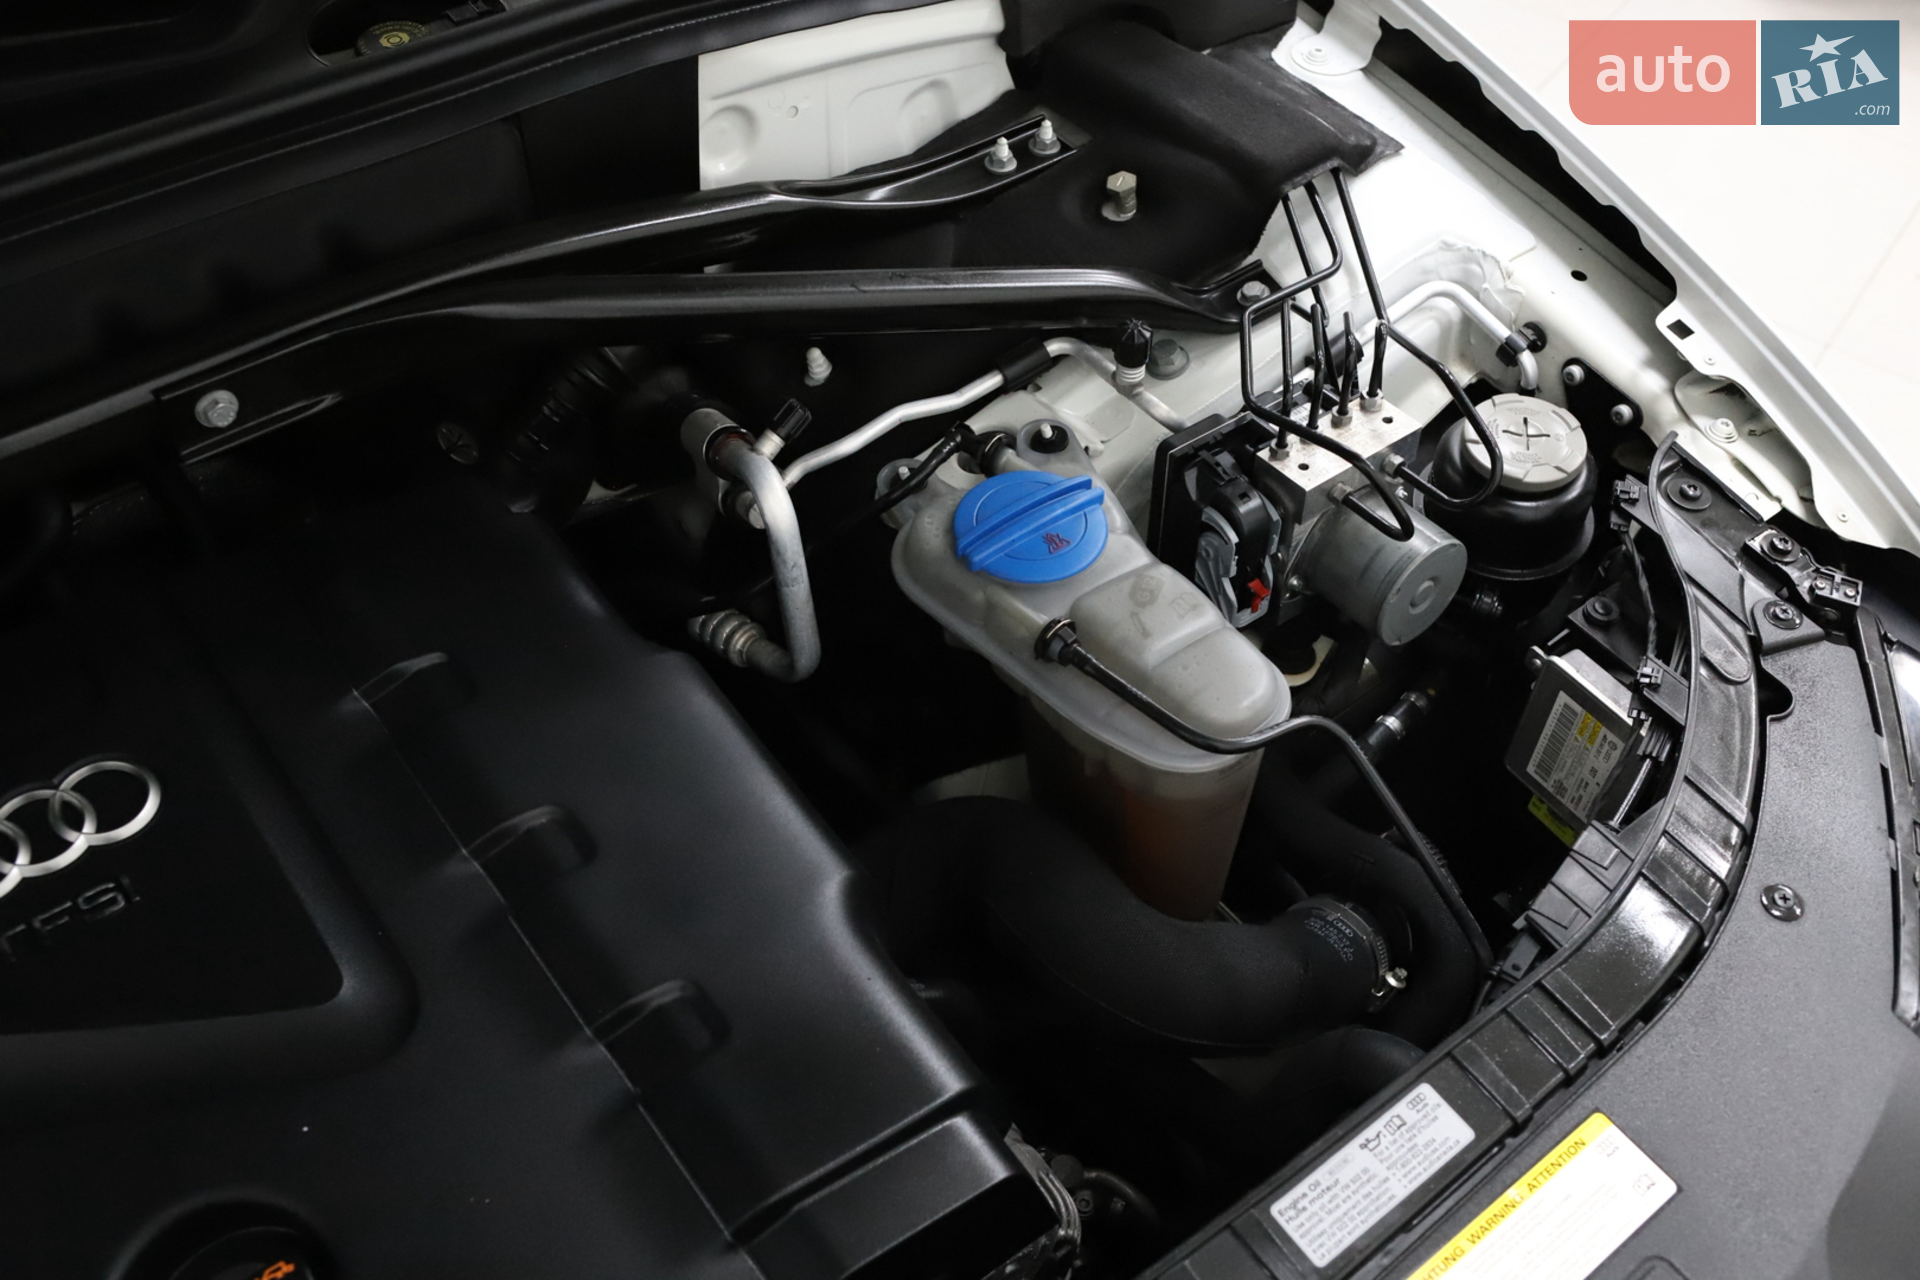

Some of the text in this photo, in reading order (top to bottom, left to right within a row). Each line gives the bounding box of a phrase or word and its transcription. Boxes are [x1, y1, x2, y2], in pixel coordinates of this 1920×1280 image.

[1276, 1178, 1322, 1219] Engine Oil
[1284, 1176, 1341, 1225] Huile moteur
[1466, 1194, 1524, 1246] WARNING
[1526, 1137, 1586, 1194] ATTENTION
